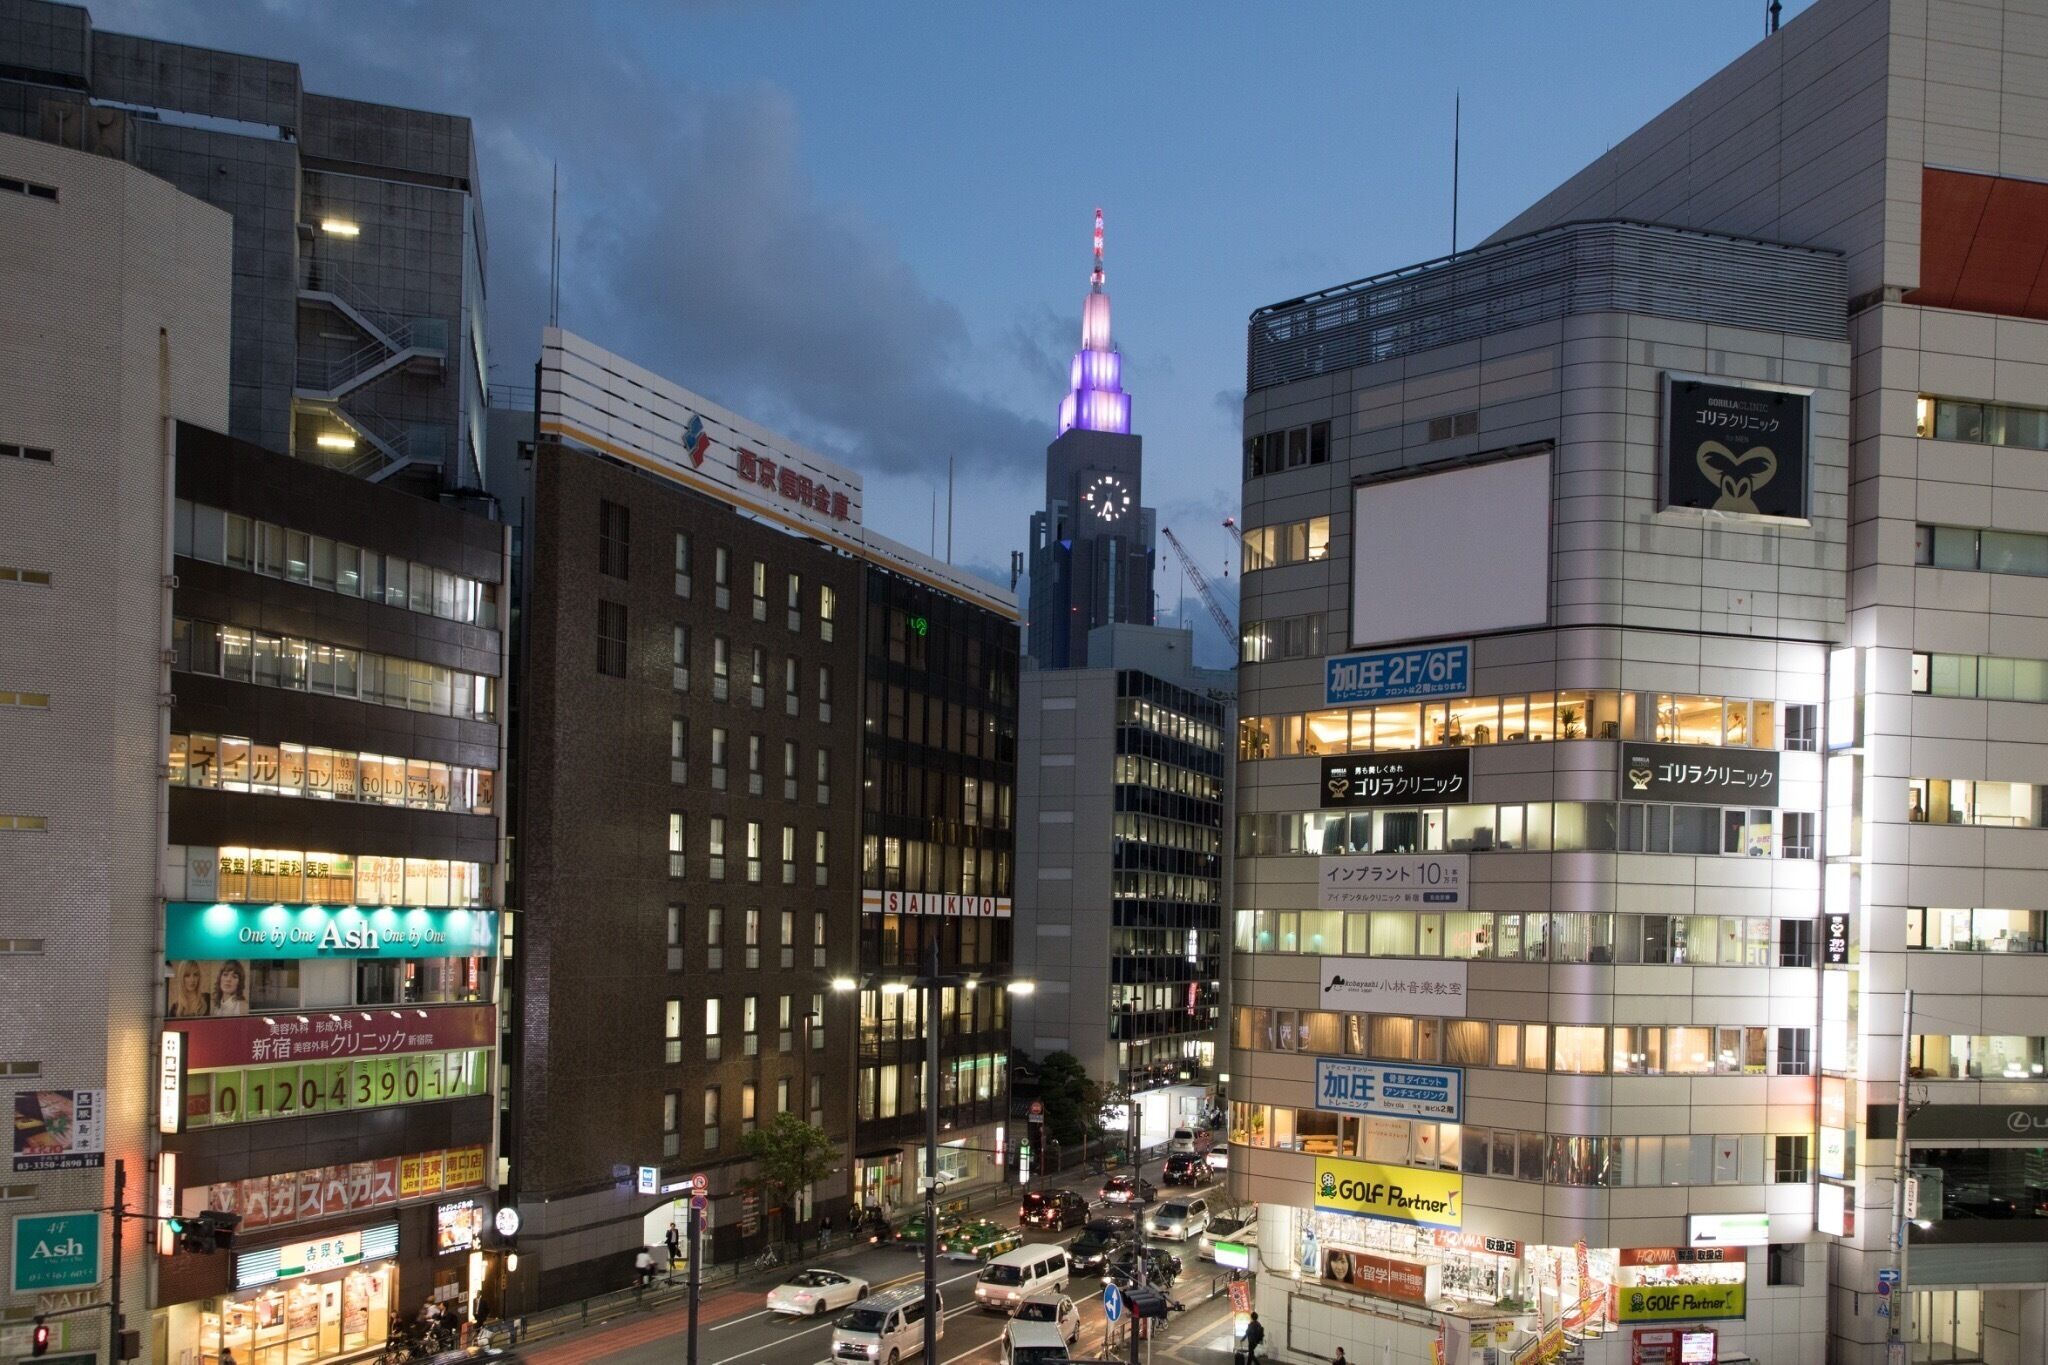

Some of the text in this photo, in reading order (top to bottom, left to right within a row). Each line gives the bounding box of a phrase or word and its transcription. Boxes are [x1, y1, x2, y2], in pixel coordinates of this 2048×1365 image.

[1708, 398, 1739, 409] GORILLA
[1696, 410, 1779, 432] ゴリラクリニック
[737, 446, 849, 521] 西京信用金庫
[1331, 650, 1463, 691] 加圧 2F/6F
[1336, 688, 1378, 699] トレーニング
[191, 746, 331, 787] ネイル サロン
[340, 758, 350, 768] 03
[1354, 765, 1404, 775] 男も美しくあれ
[1354, 774, 1463, 797] ゴリラクリニック
[1658, 763, 1773, 788] ゴリラクリニック
[336, 783, 353, 794] 1334
[1328, 863, 1441, 884] インプラント 10
[889, 893, 992, 915] SAIKYO
[239, 919, 446, 949] One by One Ash One by One
[269, 1020, 353, 1035] 美容外科 形成外科
[252, 1031, 433, 1061] 新宿 美容外科 クリニック 新宿院
[1324, 1070, 1375, 1101] 加圧
[1384, 1087, 1447, 1100] アンチエイジング
[1328, 1099, 1369, 1109] トレーニング
[247, 1170, 394, 1219] ベガスベガス
[1339, 1180, 1447, 1213] GOLF Partner
[29, 1238, 83, 1260] Ash
[1438, 1230, 1516, 1255] HONMA 取扱店
[1636, 1250, 1677, 1264] HONMA
[1697, 1248, 1724, 1261] 取扱店
[1362, 1264, 1389, 1283] 留学
[1646, 1294, 1726, 1312] GOLF Partner
